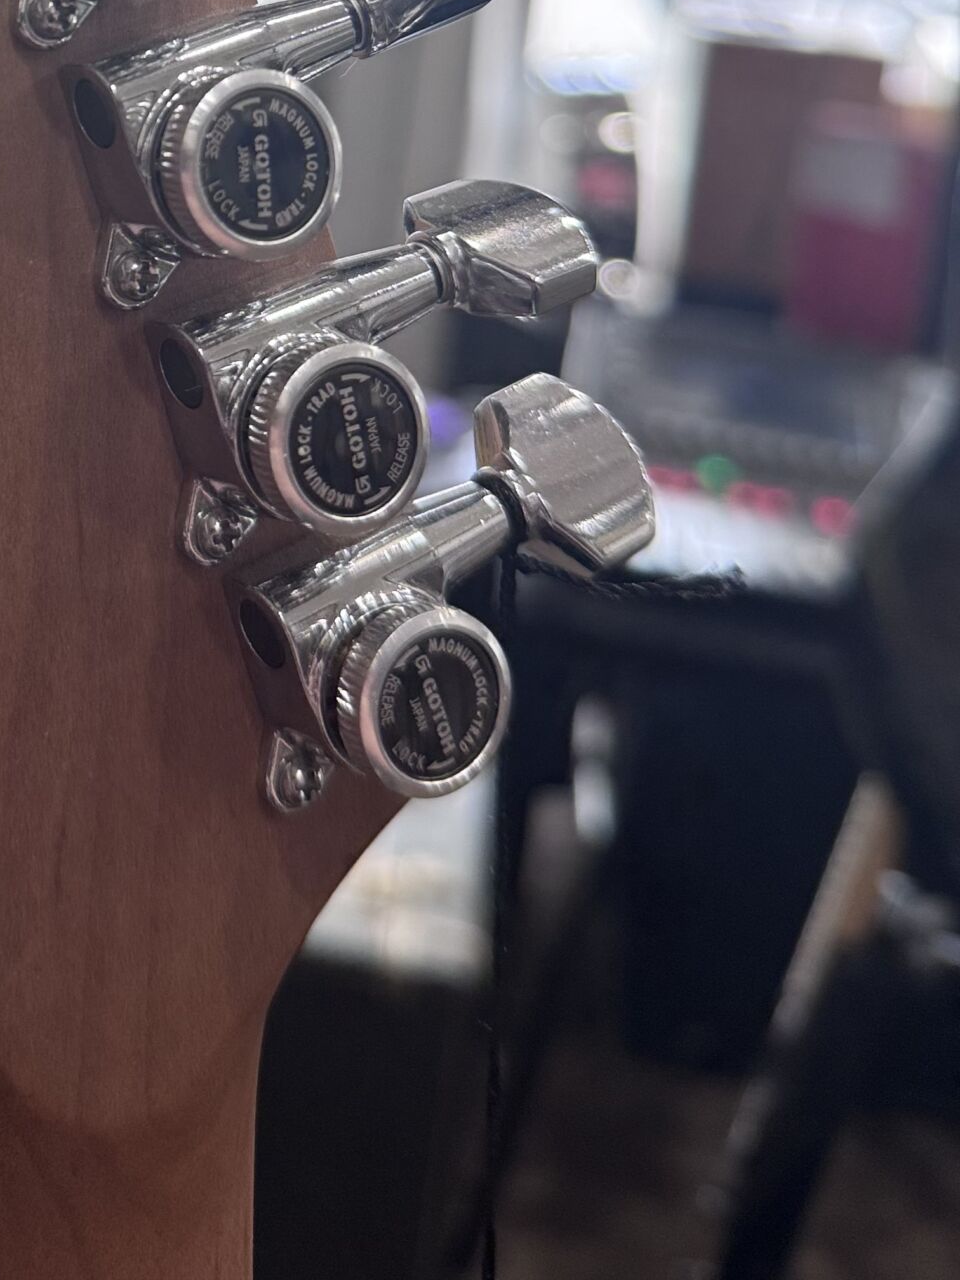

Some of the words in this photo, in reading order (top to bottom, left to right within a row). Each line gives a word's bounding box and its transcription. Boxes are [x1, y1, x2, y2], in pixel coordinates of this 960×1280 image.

[269, 98, 315, 150] MAGNUM
[237, 145, 251, 183] JAPAN
[254, 134, 273, 218] GOTOH
[302, 153, 318, 192] LOCK
[208, 179, 241, 221] LOCK
[275, 198, 306, 227] TRAD
[306, 381, 336, 413] TRAD
[371, 377, 404, 414] LOCK
[297, 424, 312, 464] LOCK
[339, 386, 367, 469] GOTOH
[365, 416, 382, 453] JAPAN
[387, 431, 411, 483] RELEASE
[303, 465, 356, 508] MAGNUM
[428, 637, 478, 671] MAGNUM
[380, 672, 403, 727] RELEASE
[472, 668, 488, 706] LOCK
[409, 697, 429, 732] JAPAN
[422, 677, 457, 757] GOTOH
[458, 716, 484, 753] TRAD
[392, 738, 427, 771] LOCK
